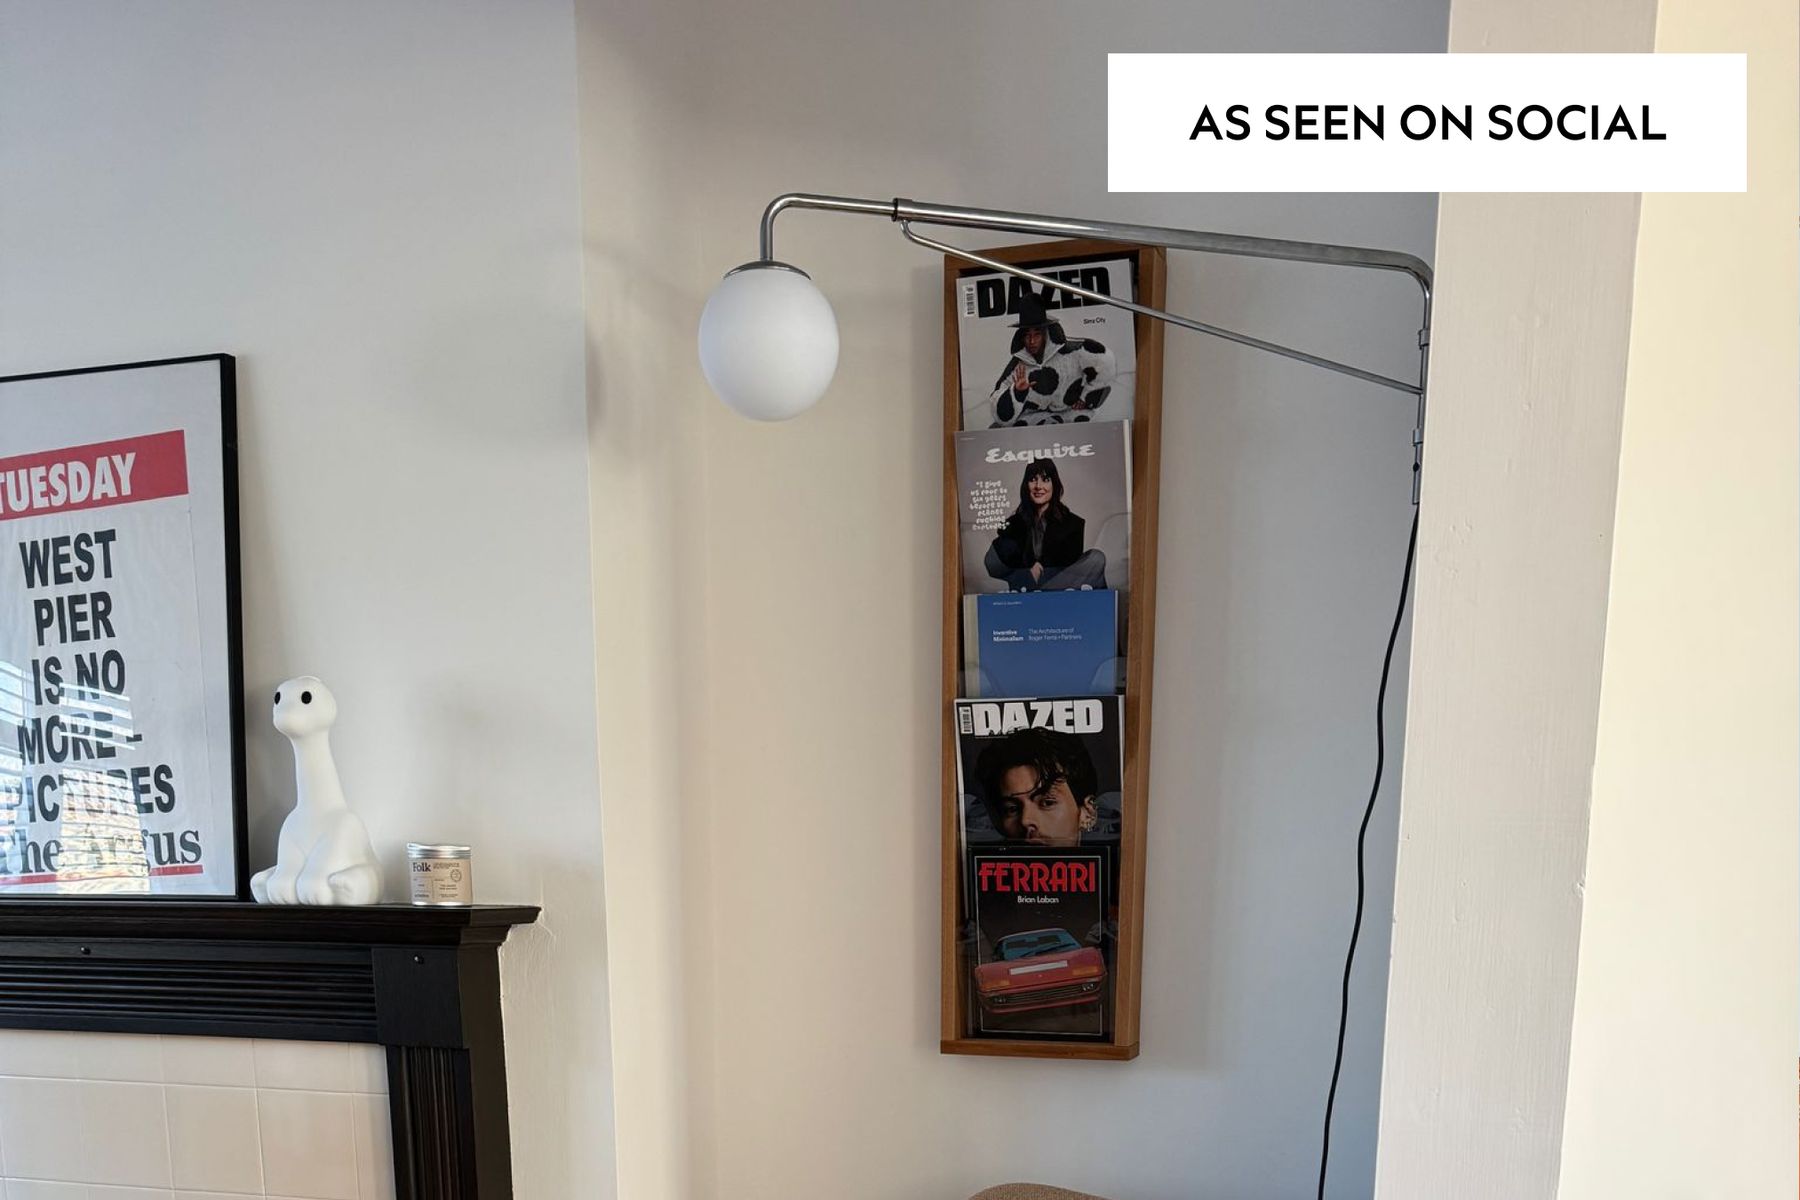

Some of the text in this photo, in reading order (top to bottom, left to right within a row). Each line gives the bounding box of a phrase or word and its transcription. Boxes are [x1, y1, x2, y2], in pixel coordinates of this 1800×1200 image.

[976, 267, 1111, 318] DAZED
[985, 443, 1096, 464] Esquire
[0, 452, 136, 514] UESDAY
[19, 529, 117, 589] WEST
[33, 591, 116, 646] PIER
[32, 649, 126, 706] IS NO
[17, 711, 117, 766] MORE
[972, 699, 1103, 736] DAZED
[412, 861, 432, 873] Folk
[978, 861, 1096, 892] FERRARI
[1017, 895, 1060, 904] Brian Laban
